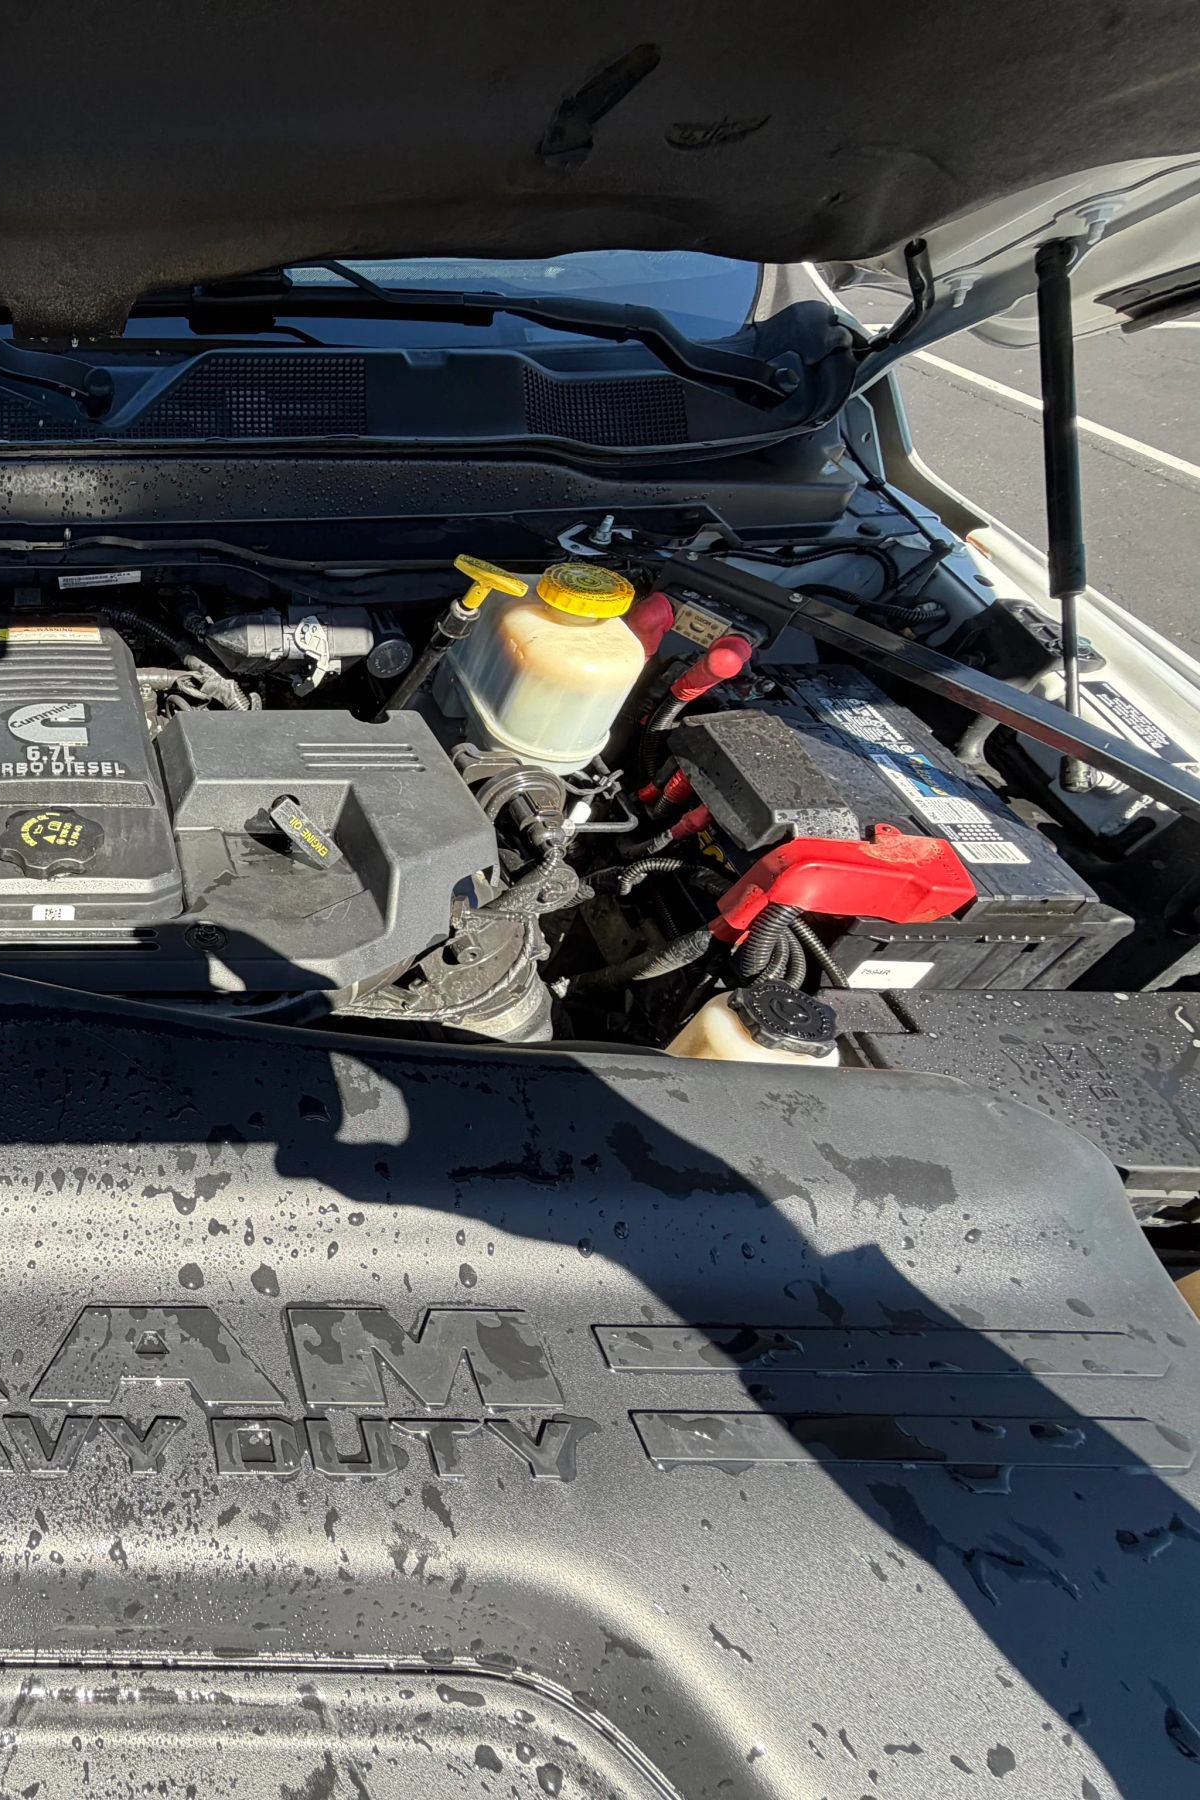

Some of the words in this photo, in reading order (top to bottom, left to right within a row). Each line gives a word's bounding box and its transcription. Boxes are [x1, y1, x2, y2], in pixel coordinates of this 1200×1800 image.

[9, 702, 78, 729] Cummins
[26, 745, 75, 762] 6.7L
[51, 761, 126, 777] DIESEL
[289, 815, 303, 832] OIL
[300, 828, 329, 857] ENGINE
[209, 1415, 580, 1480] DUTY
